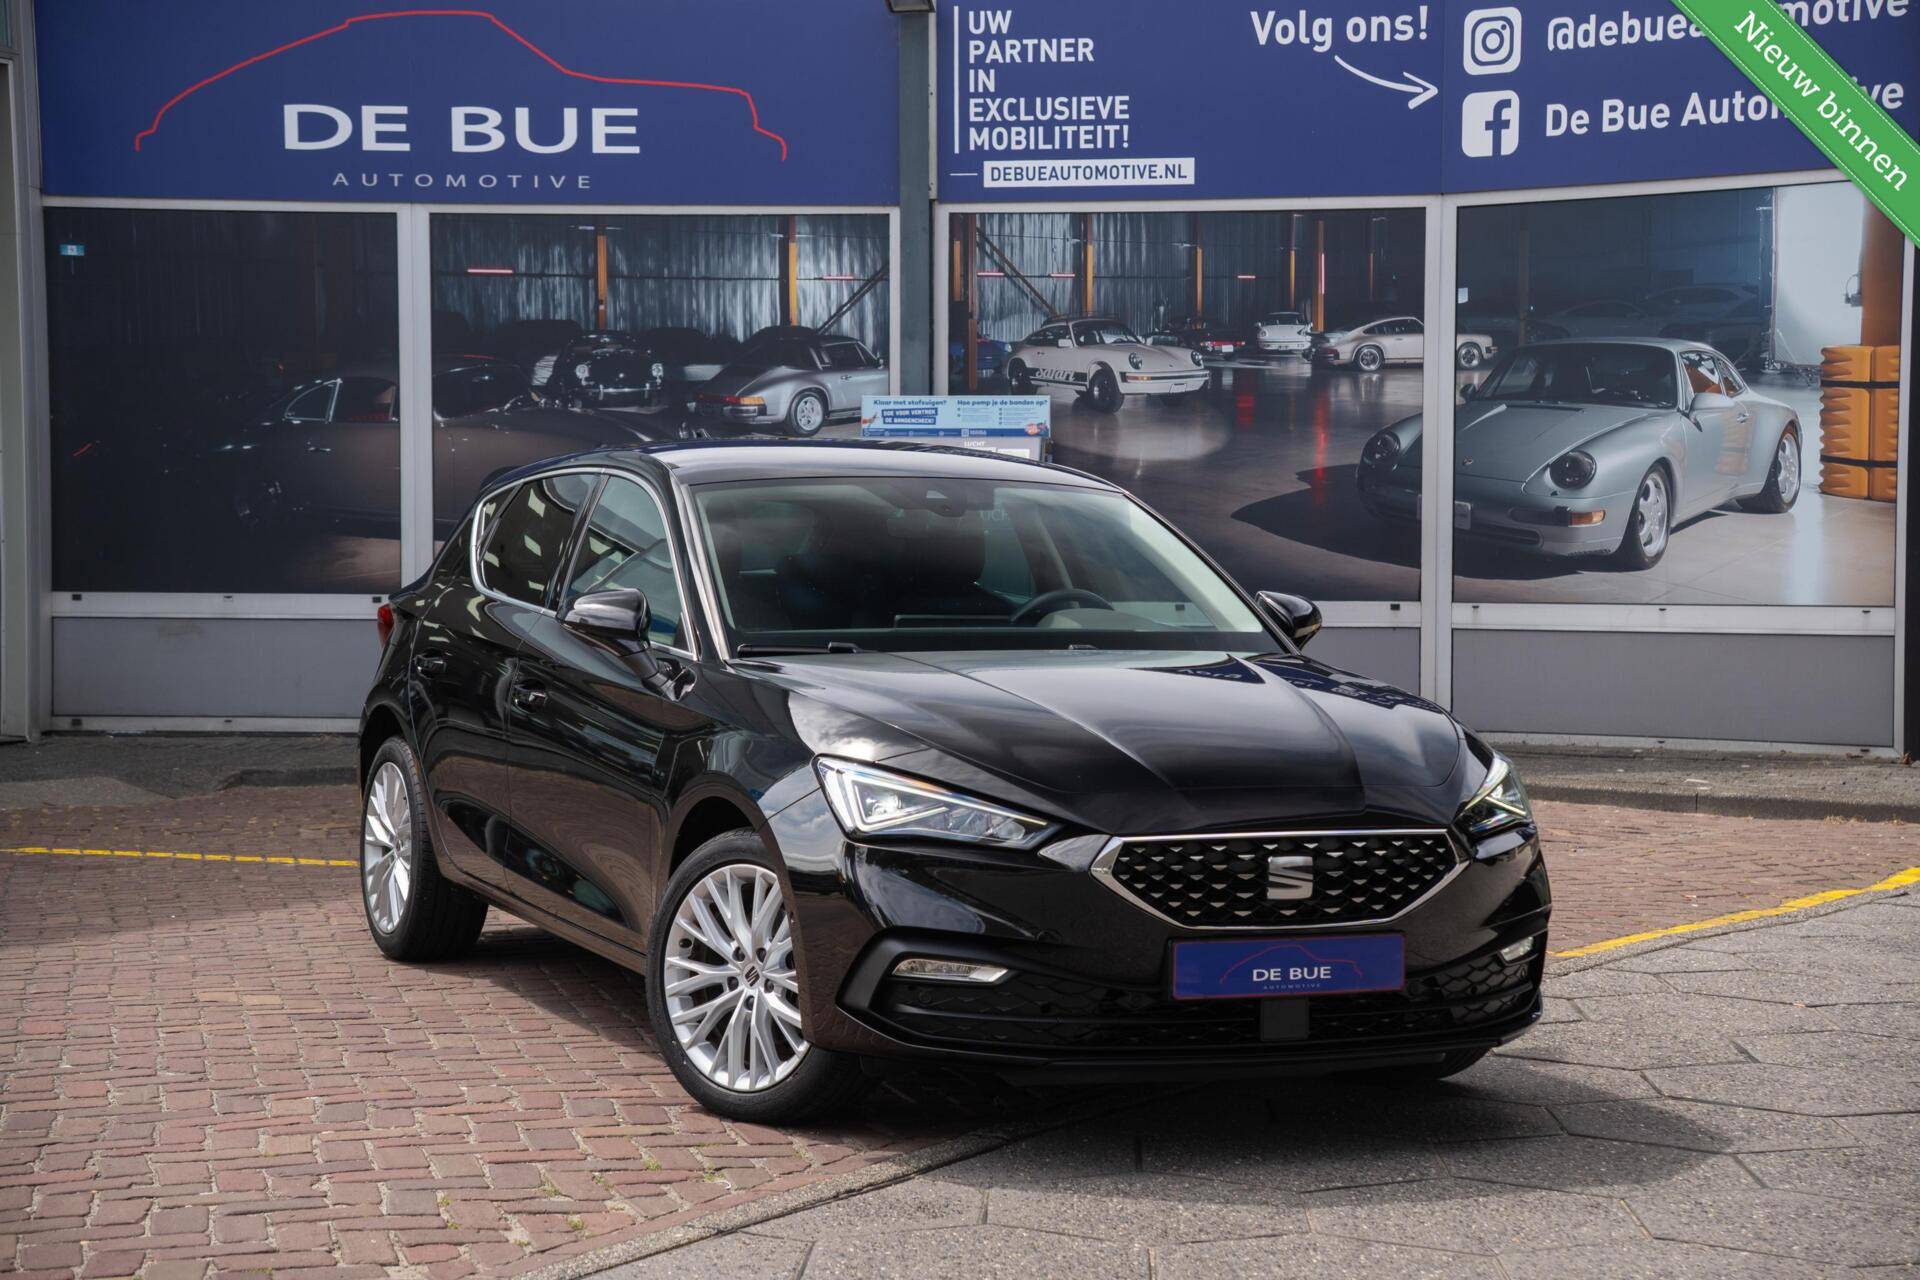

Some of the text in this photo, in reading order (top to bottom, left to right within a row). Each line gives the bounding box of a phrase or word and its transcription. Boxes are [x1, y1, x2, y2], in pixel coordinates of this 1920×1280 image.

[968, 9, 1013, 35] UW
[1250, 5, 1429, 53] Volg ons!
[1547, 0, 1909, 51] @debuemotive
[968, 37, 1095, 64] PARTNER
[968, 68, 996, 93] IN
[968, 95, 1130, 122] EXCLUSIEVE
[1545, 103, 1590, 137] De
[1601, 98, 1671, 133] Bue
[283, 103, 641, 154] DE BUE
[968, 124, 1130, 151] MOBILITEIT!
[333, 173, 591, 190] AUTOMOTIVE
[989, 164, 1188, 183] DEBUEAUTOMOTIVE.NL
[1252, 966, 1332, 982] DE BUE
